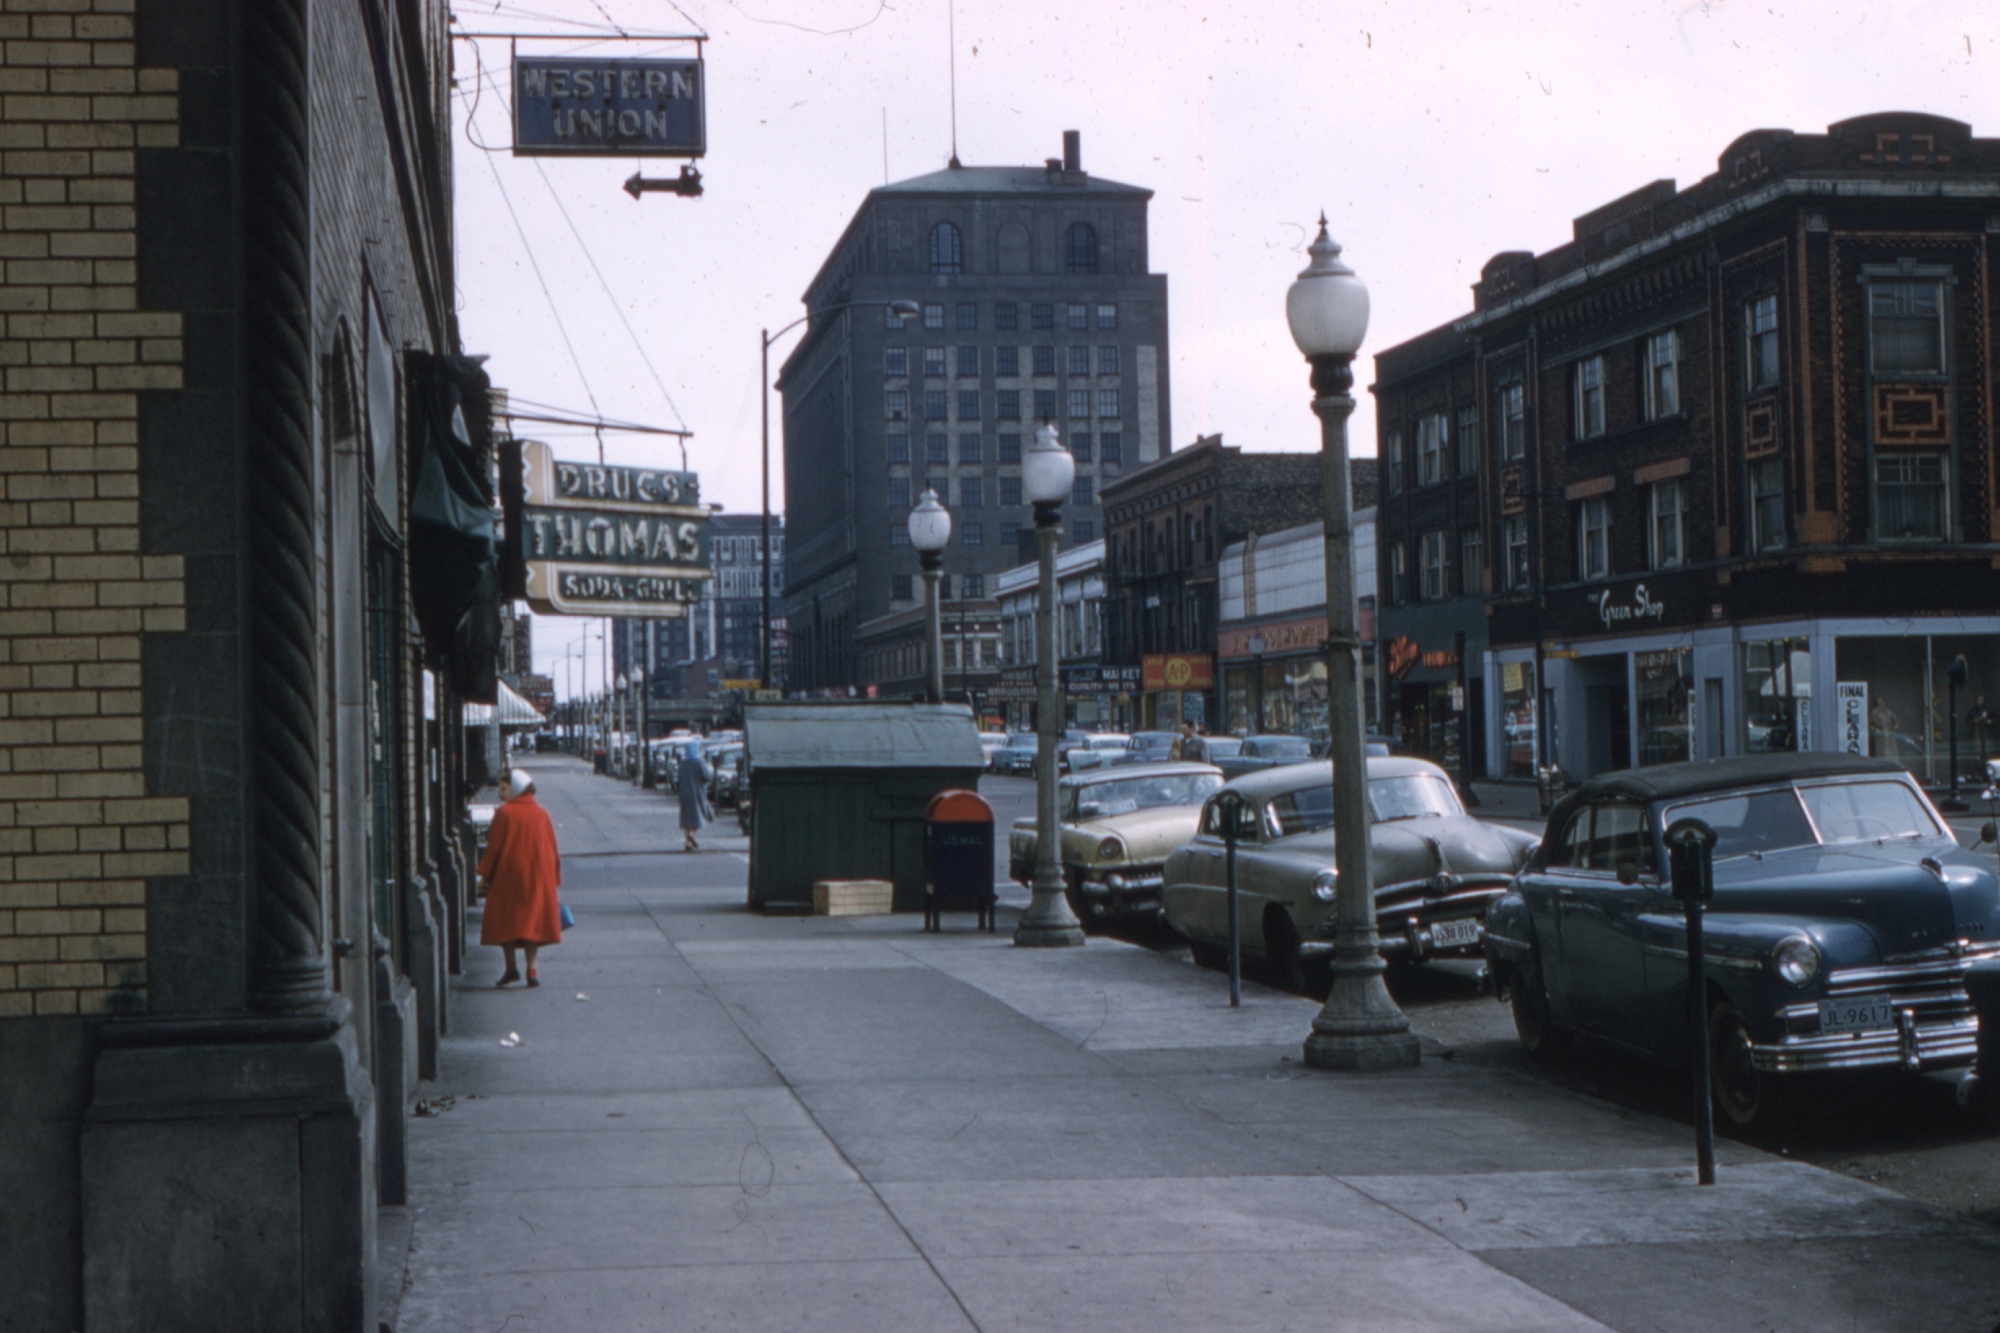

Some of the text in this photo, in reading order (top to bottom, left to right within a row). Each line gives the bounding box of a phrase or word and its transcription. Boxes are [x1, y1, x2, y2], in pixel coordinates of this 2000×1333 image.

[522, 67, 694, 100] WESTERN
[552, 108, 667, 139] UNION
[558, 464, 681, 503] DRUGS
[526, 512, 700, 562] THOMAS
[1599, 589, 1631, 631] Green
[1633, 583, 1664, 622] Shop
[1839, 685, 1865, 698] FINAL
[1457, 923, 1475, 938] 019
